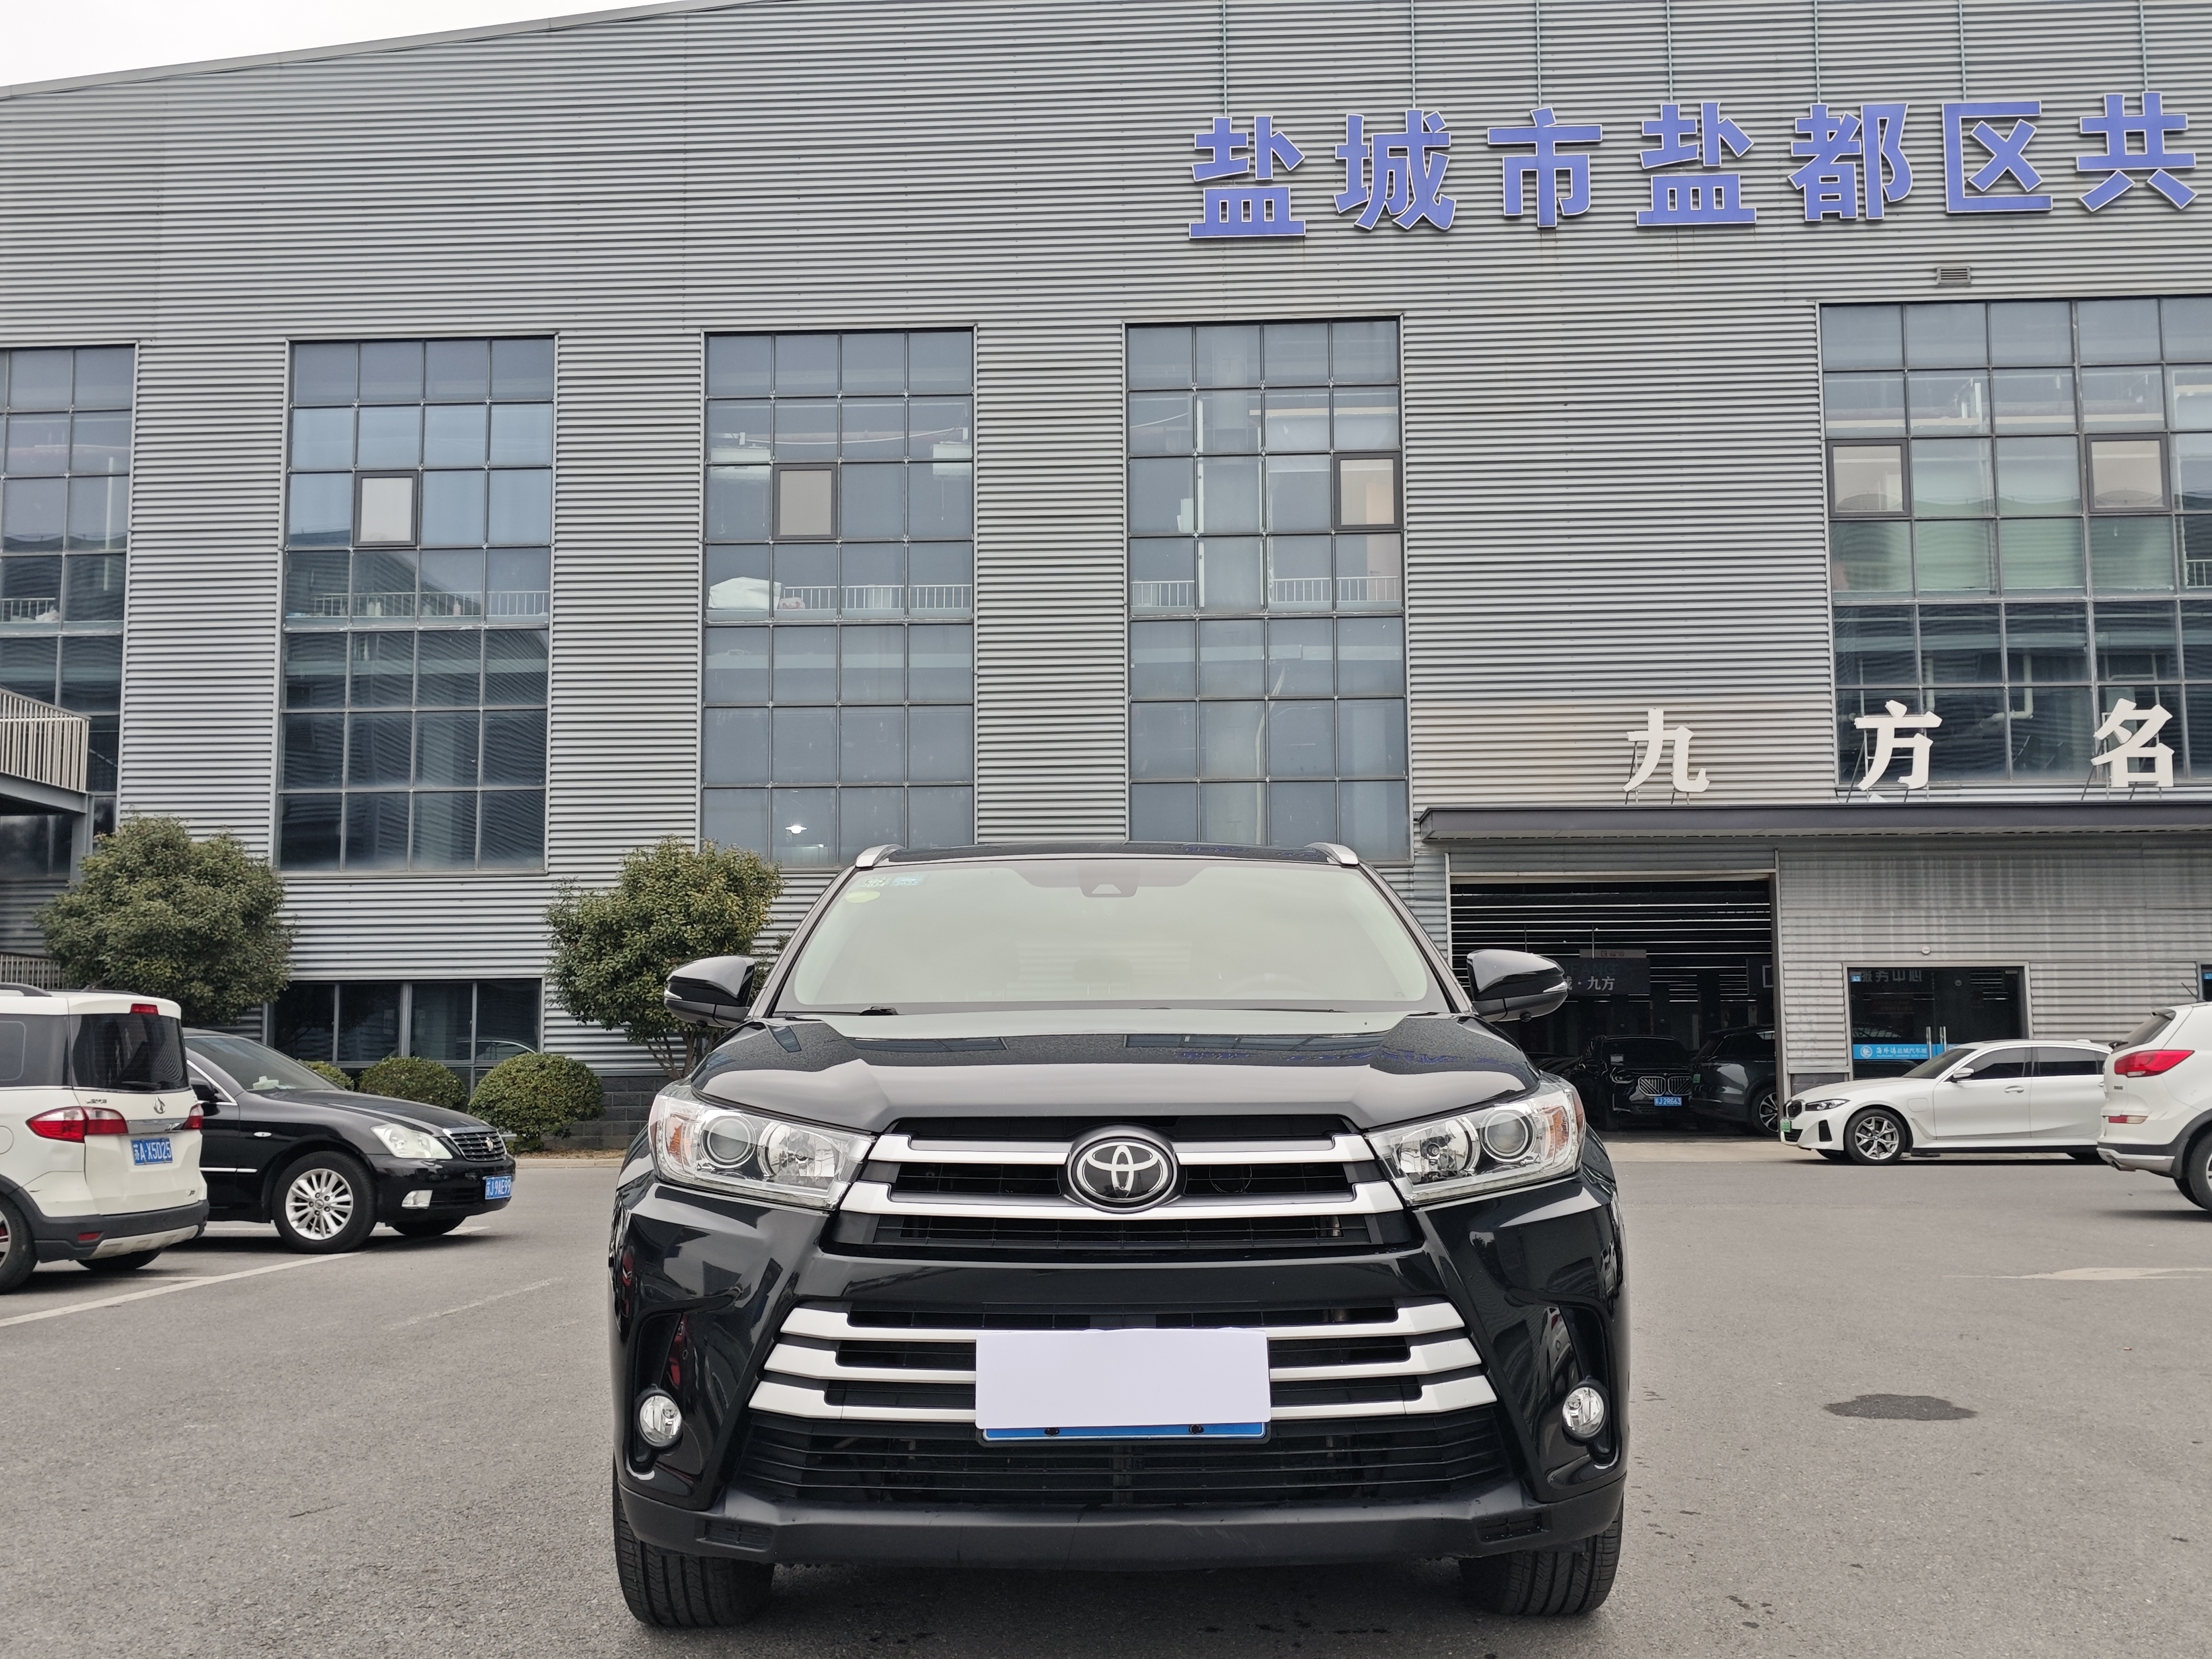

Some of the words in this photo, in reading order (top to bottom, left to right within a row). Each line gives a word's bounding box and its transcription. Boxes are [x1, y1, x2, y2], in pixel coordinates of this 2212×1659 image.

[1189, 90, 2198, 239] 盐城市盐都区共
[1623, 698, 2175, 794] 九方名
